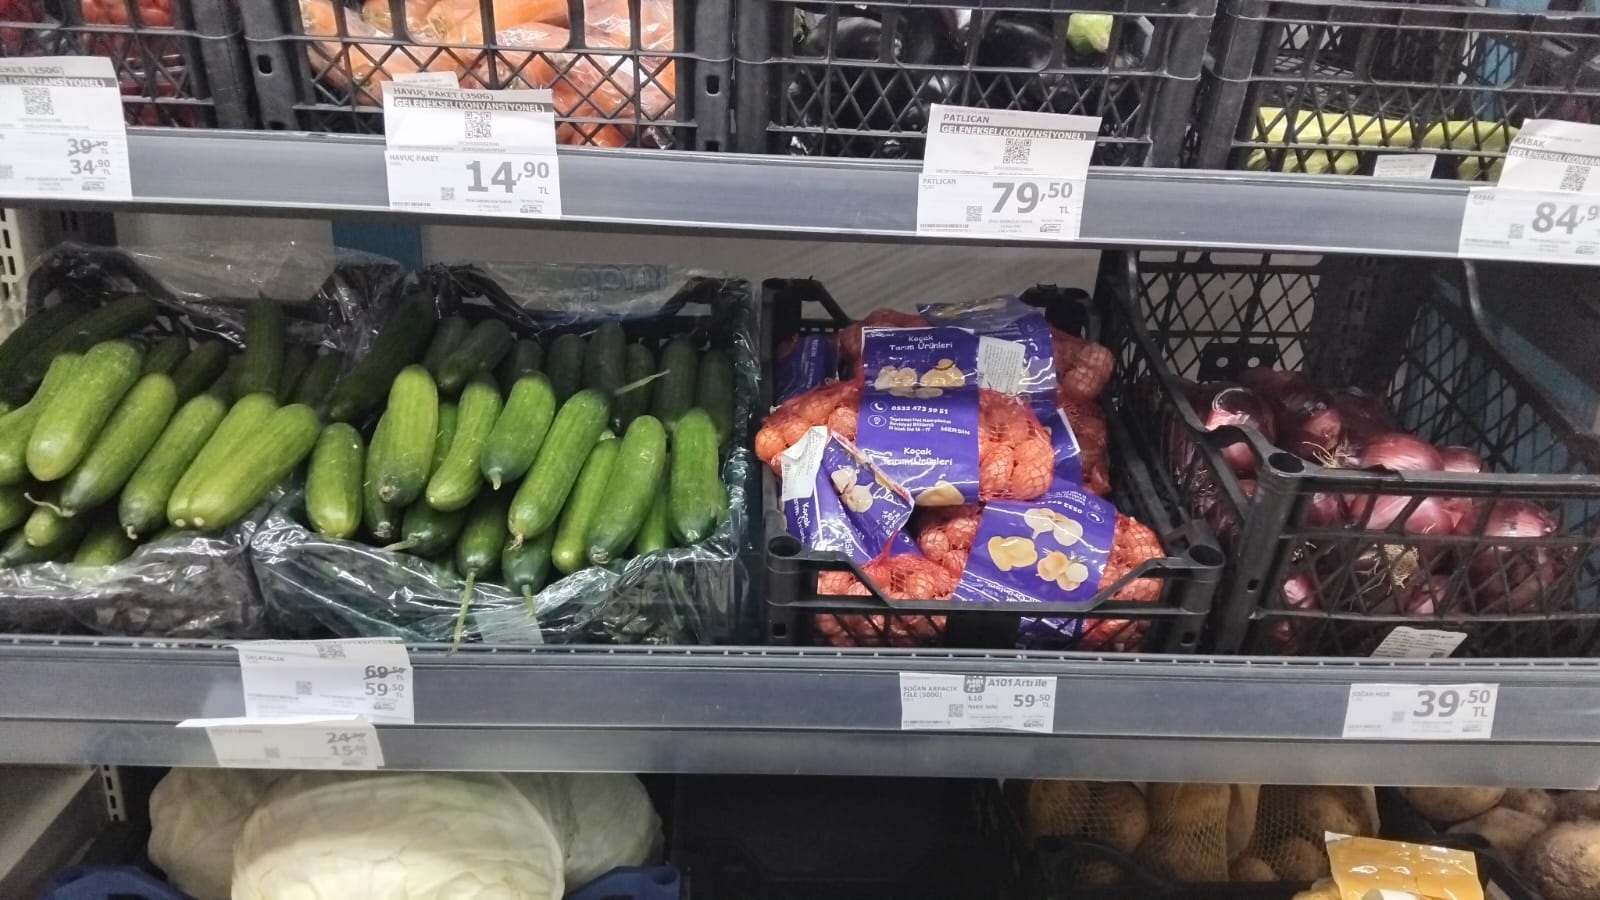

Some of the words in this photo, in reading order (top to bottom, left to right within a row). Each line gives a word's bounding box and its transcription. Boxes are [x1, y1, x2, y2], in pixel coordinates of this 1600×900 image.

[393, 87, 426, 96] HAVUÇ
[428, 89, 457, 98] PAKET
[461, 92, 494, 100] (350G)
[944, 113, 990, 124] PATLICAN
[465, 160, 549, 194] 14,90
[538, 187, 550, 195] TL
[992, 182, 1073, 214] 79,50
[1059, 206, 1070, 214] TL
[908, 335, 934, 343] Koçak
[917, 341, 953, 350] Ürünleri
[903, 447, 932, 457] Koçak
[1413, 690, 1490, 717] 39,50
[1472, 707, 1488, 717] TL
